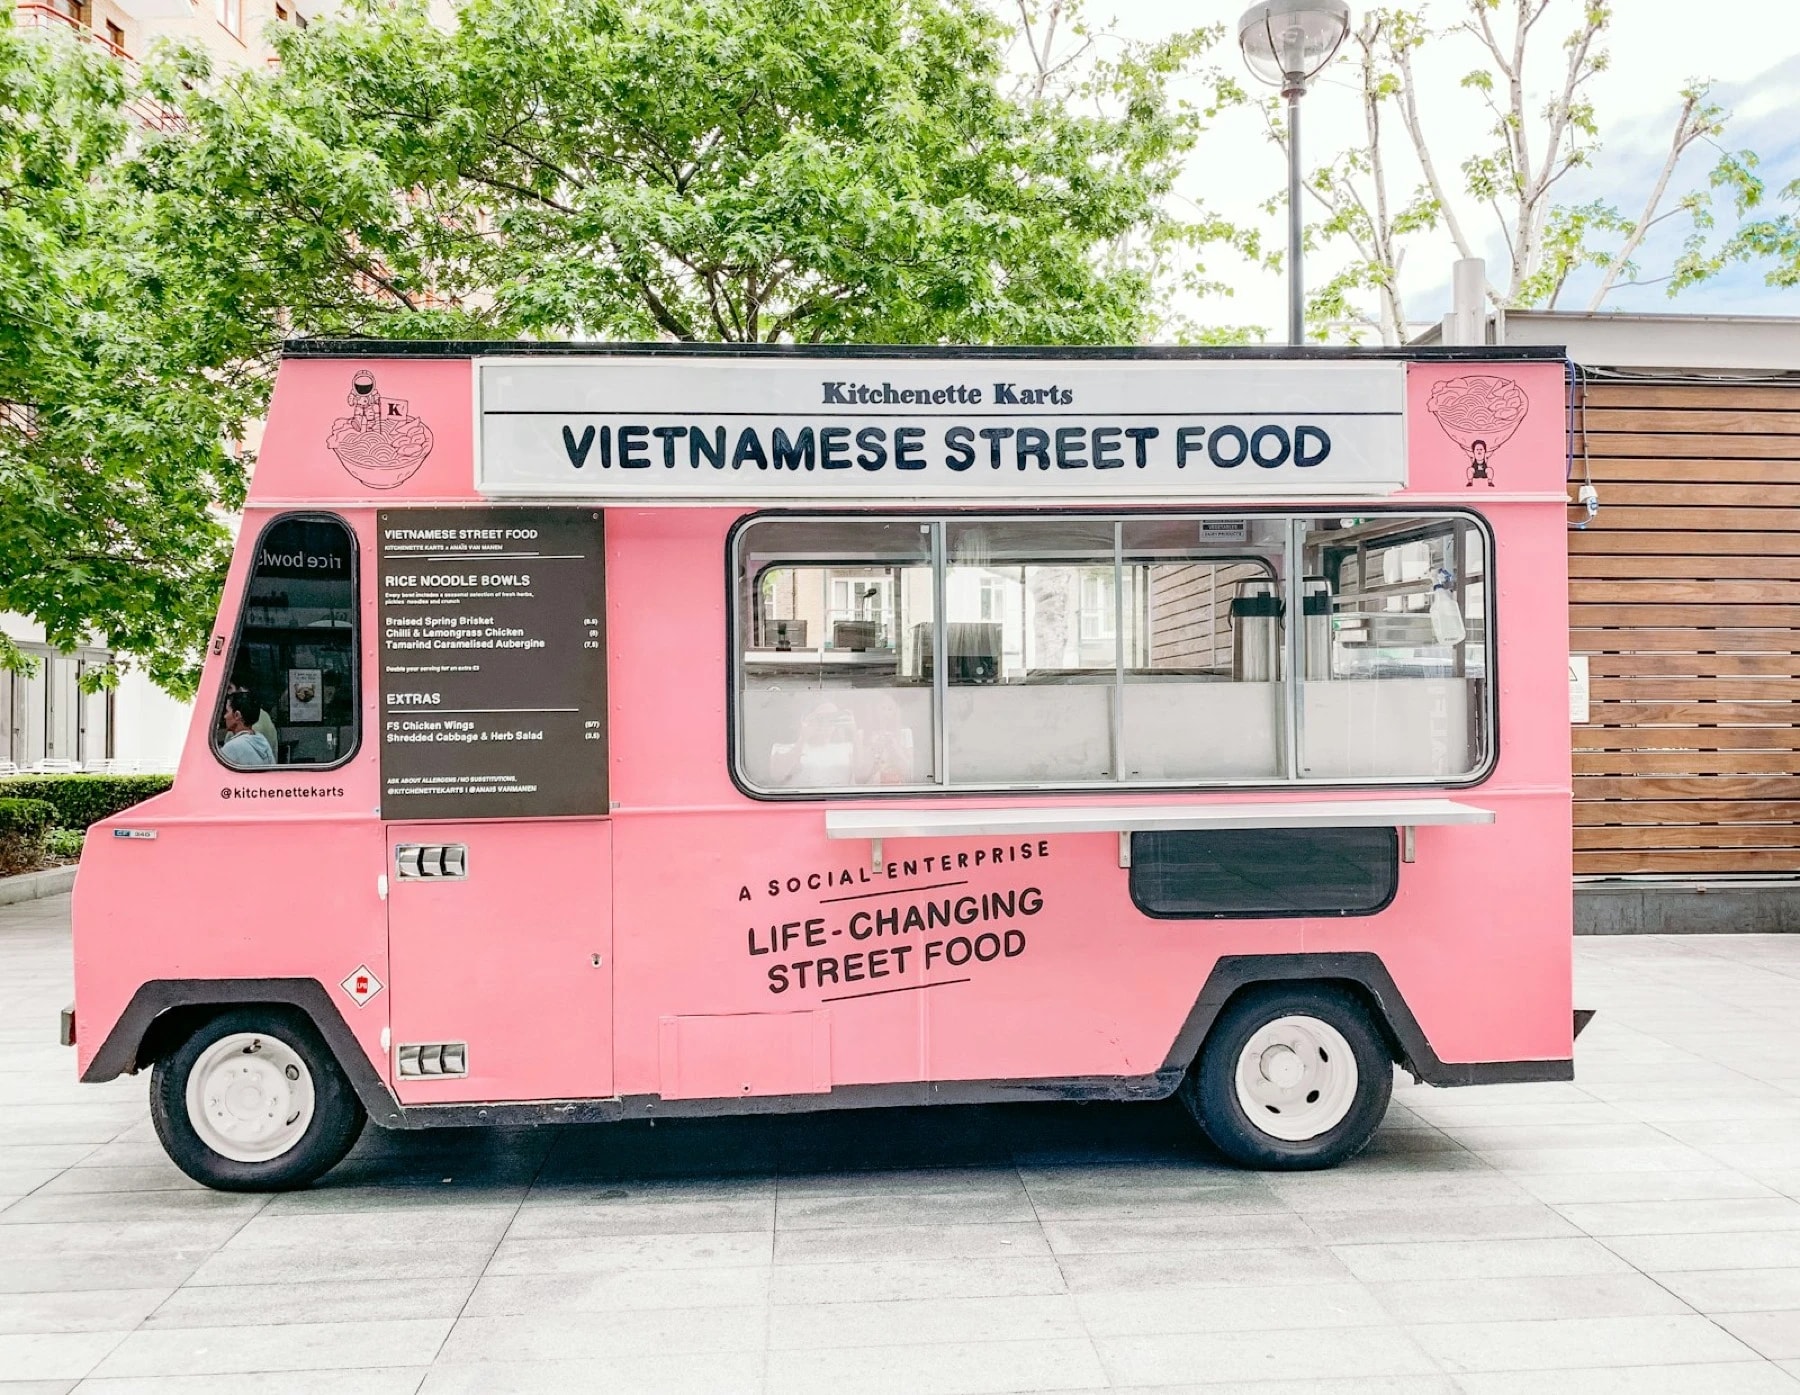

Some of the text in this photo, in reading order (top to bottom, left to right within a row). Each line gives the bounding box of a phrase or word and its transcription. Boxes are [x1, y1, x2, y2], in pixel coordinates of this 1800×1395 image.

[822, 382, 1073, 405] Kitchenette Karts
[388, 403, 402, 416] K
[562, 424, 1332, 471] VIETNAMESE STREET FOOD
[384, 529, 538, 540] VIETNAMESE STREET FOOD
[385, 574, 531, 587] RICE NOODLE BOWLS
[386, 616, 423, 626] Braised
[425, 616, 457, 627] Spring
[459, 616, 494, 625] Brisket
[386, 628, 411, 637] Chilli
[413, 628, 420, 637] &
[423, 628, 482, 639] Lemongrass
[485, 627, 524, 637] Chicken
[386, 640, 431, 649] Tamarind
[434, 639, 494, 649] Caramelised
[496, 639, 545, 650] Aubergine
[387, 693, 441, 705] EXTRAS
[387, 721, 400, 731] FS
[402, 721, 442, 730] Chicken
[443, 720, 475, 731] Wings
[387, 733, 434, 743] Shredded
[436, 732, 478, 743] Cabbage
[481, 732, 488, 741] &
[491, 731, 514, 741] Herb
[516, 731, 543, 740] Salad
[220, 786, 345, 800] @kitchenettekarts
[387, 787, 464, 795] @KITCHENETTEKARTS
[738, 840, 1050, 902] A SOCIAL ENTERPRISE
[767, 929, 1026, 994] STREET FOOD
